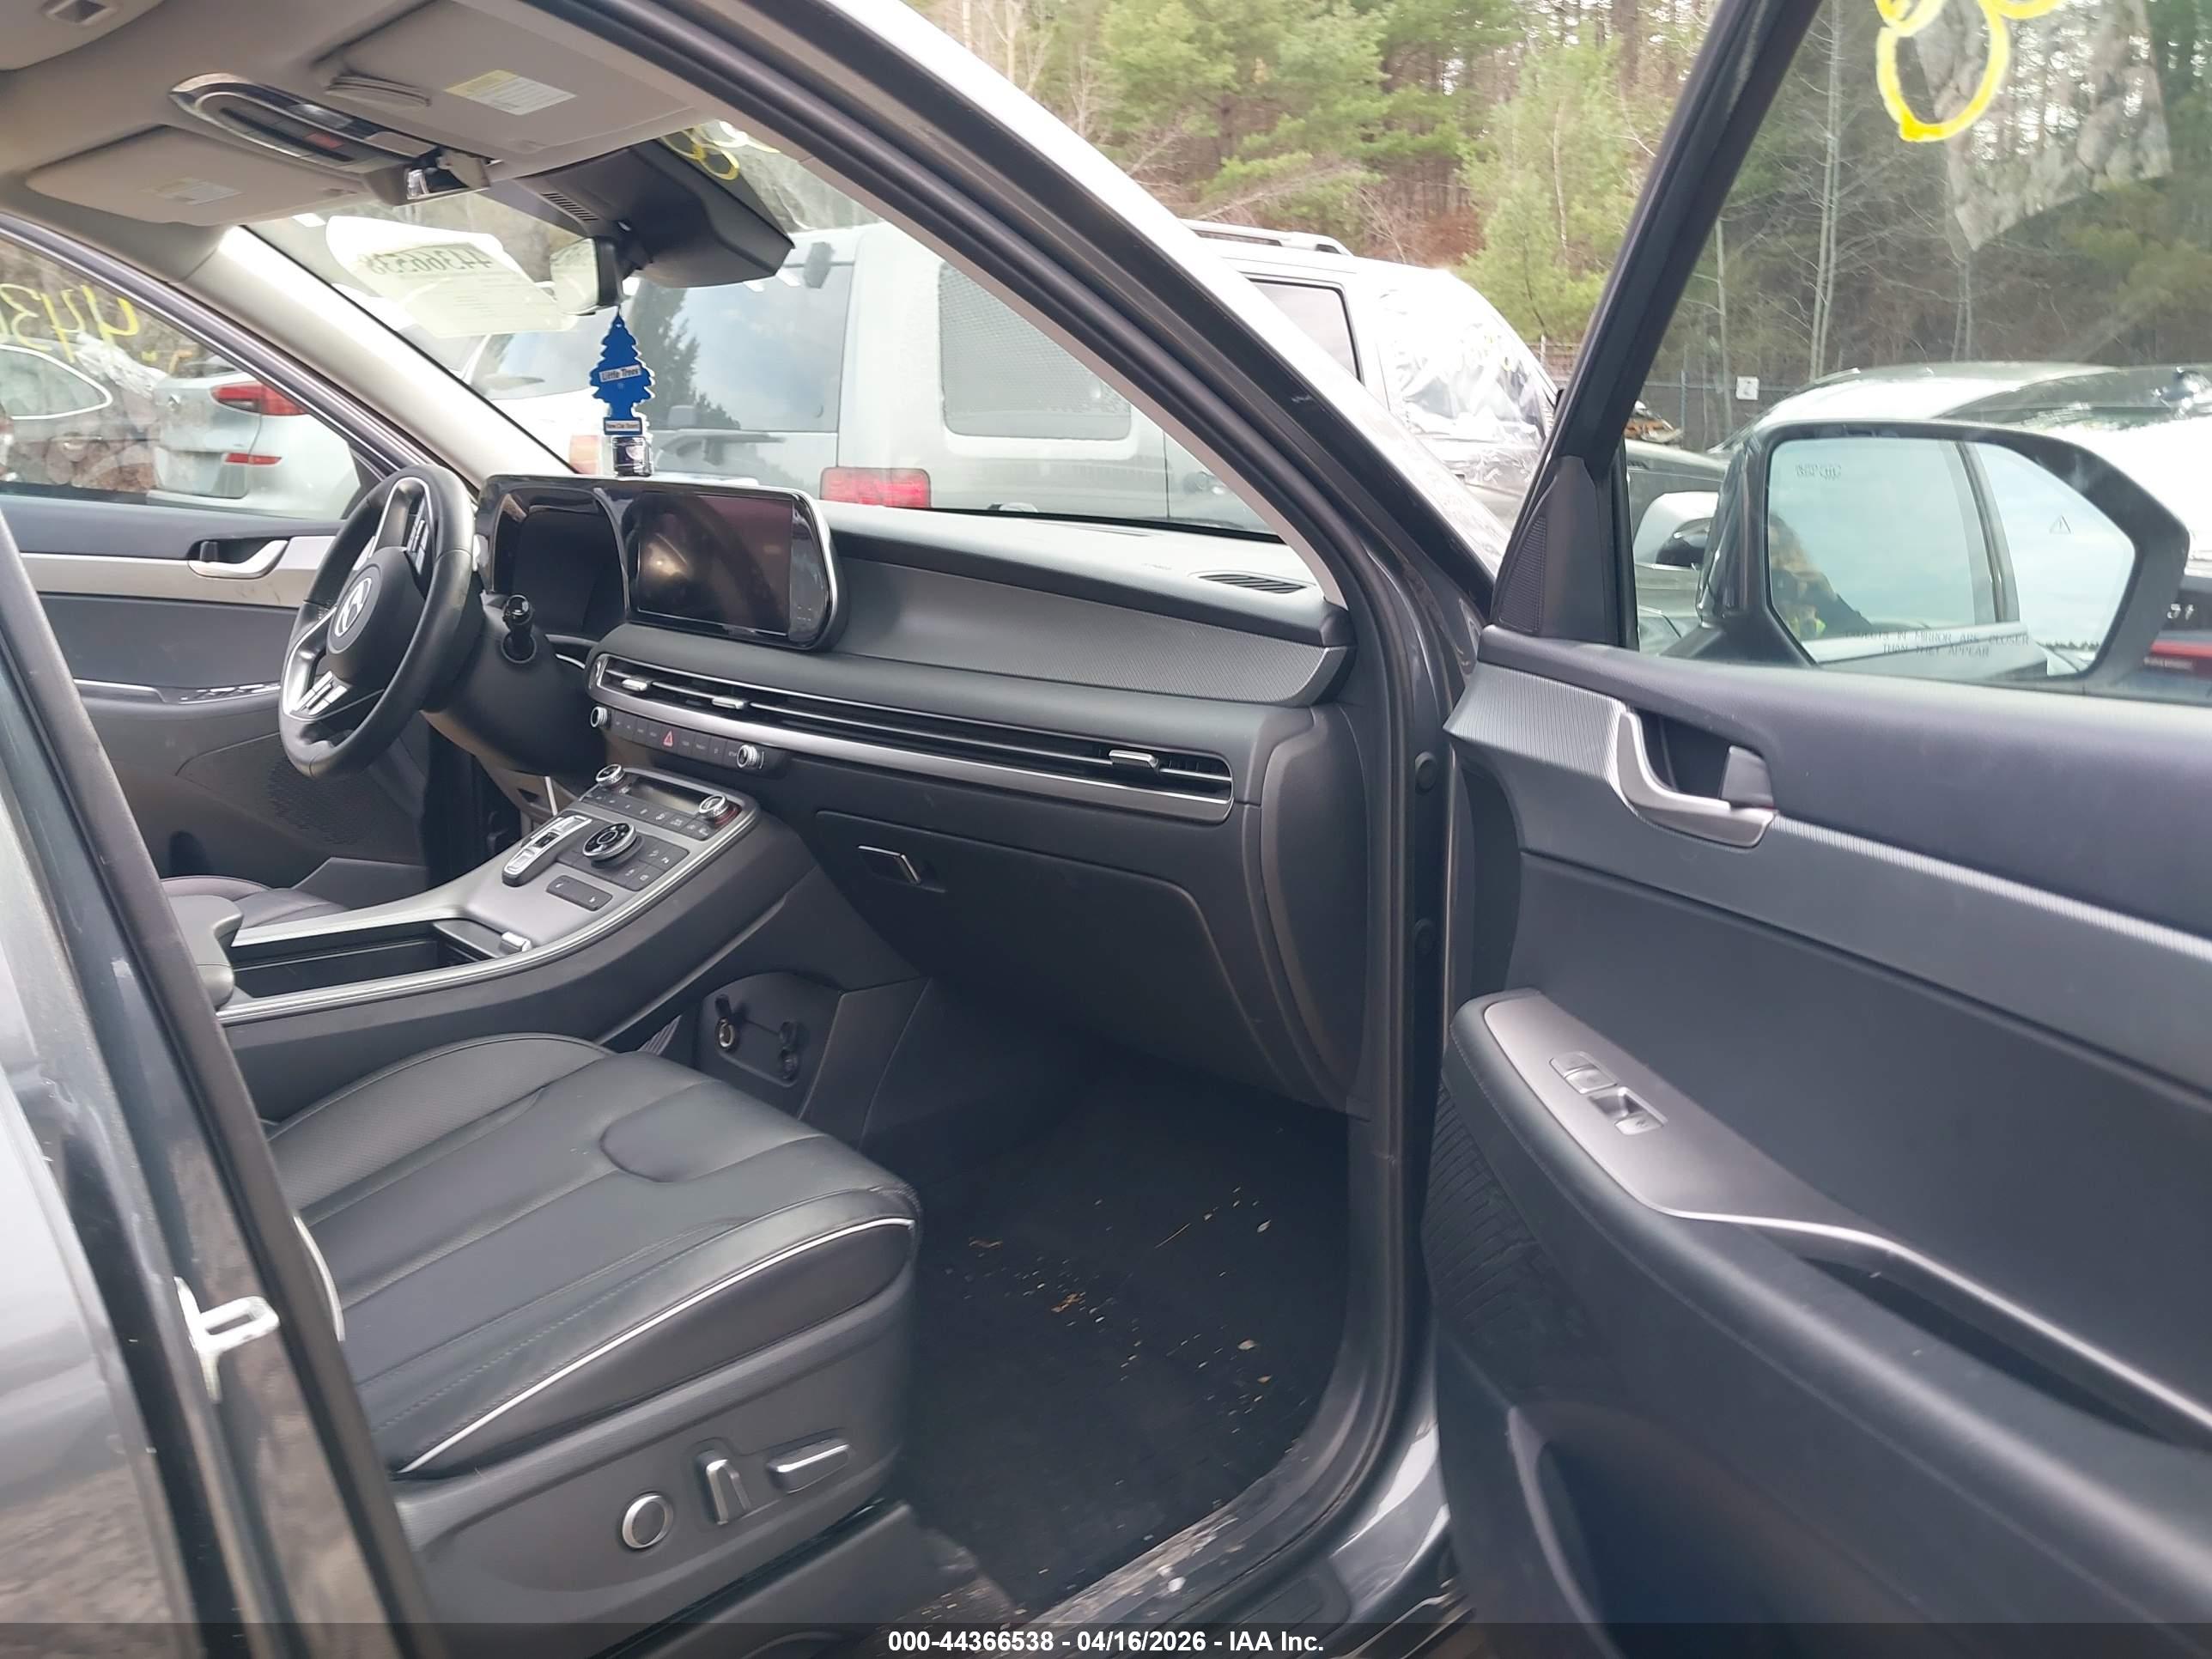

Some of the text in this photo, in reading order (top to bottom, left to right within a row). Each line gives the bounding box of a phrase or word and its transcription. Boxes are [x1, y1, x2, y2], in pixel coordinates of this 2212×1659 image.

[603, 368, 638, 380] Little Trees
[1845, 631, 1888, 640] JECTS
[1915, 631, 1952, 643] MIRROR
[1959, 633, 1978, 643] ARE
[1989, 634, 2028, 646] CLOSER
[1882, 644, 1908, 654] THAN
[1948, 646, 1989, 658] APPEAR
